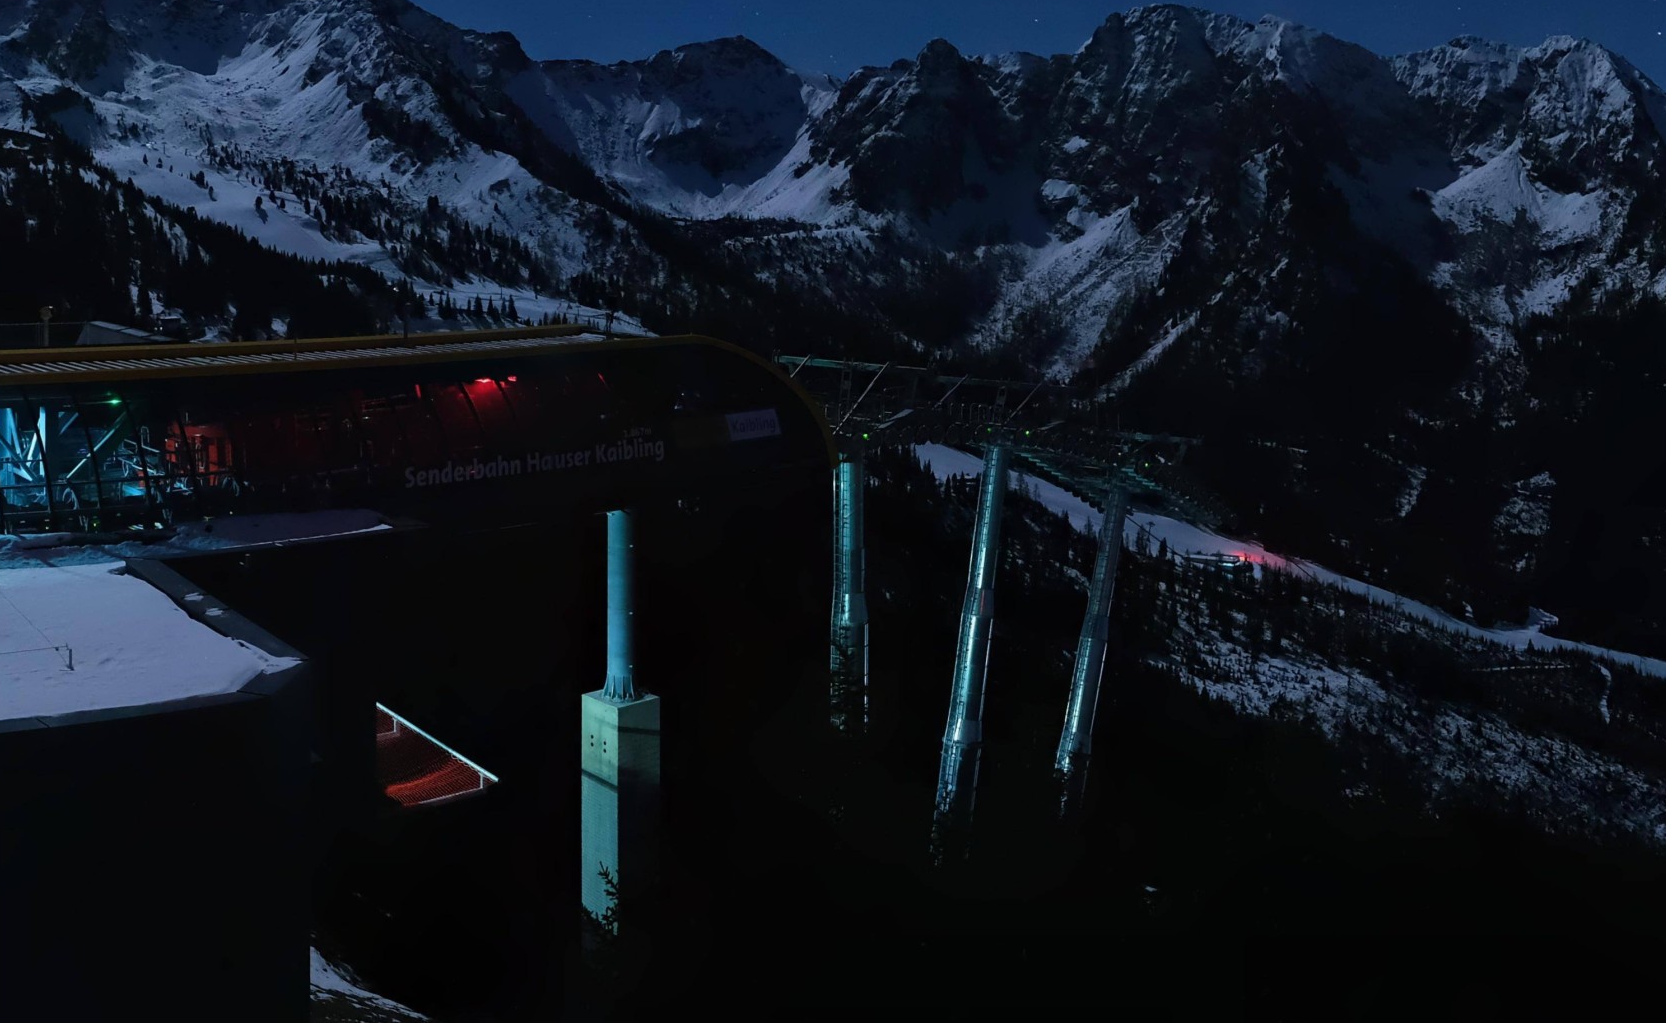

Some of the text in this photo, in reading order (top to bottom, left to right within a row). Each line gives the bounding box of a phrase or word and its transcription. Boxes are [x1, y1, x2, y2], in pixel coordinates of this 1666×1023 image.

[732, 417, 777, 435] Kaibling
[404, 436, 666, 489] Senderbahn Hauser Kaibling
